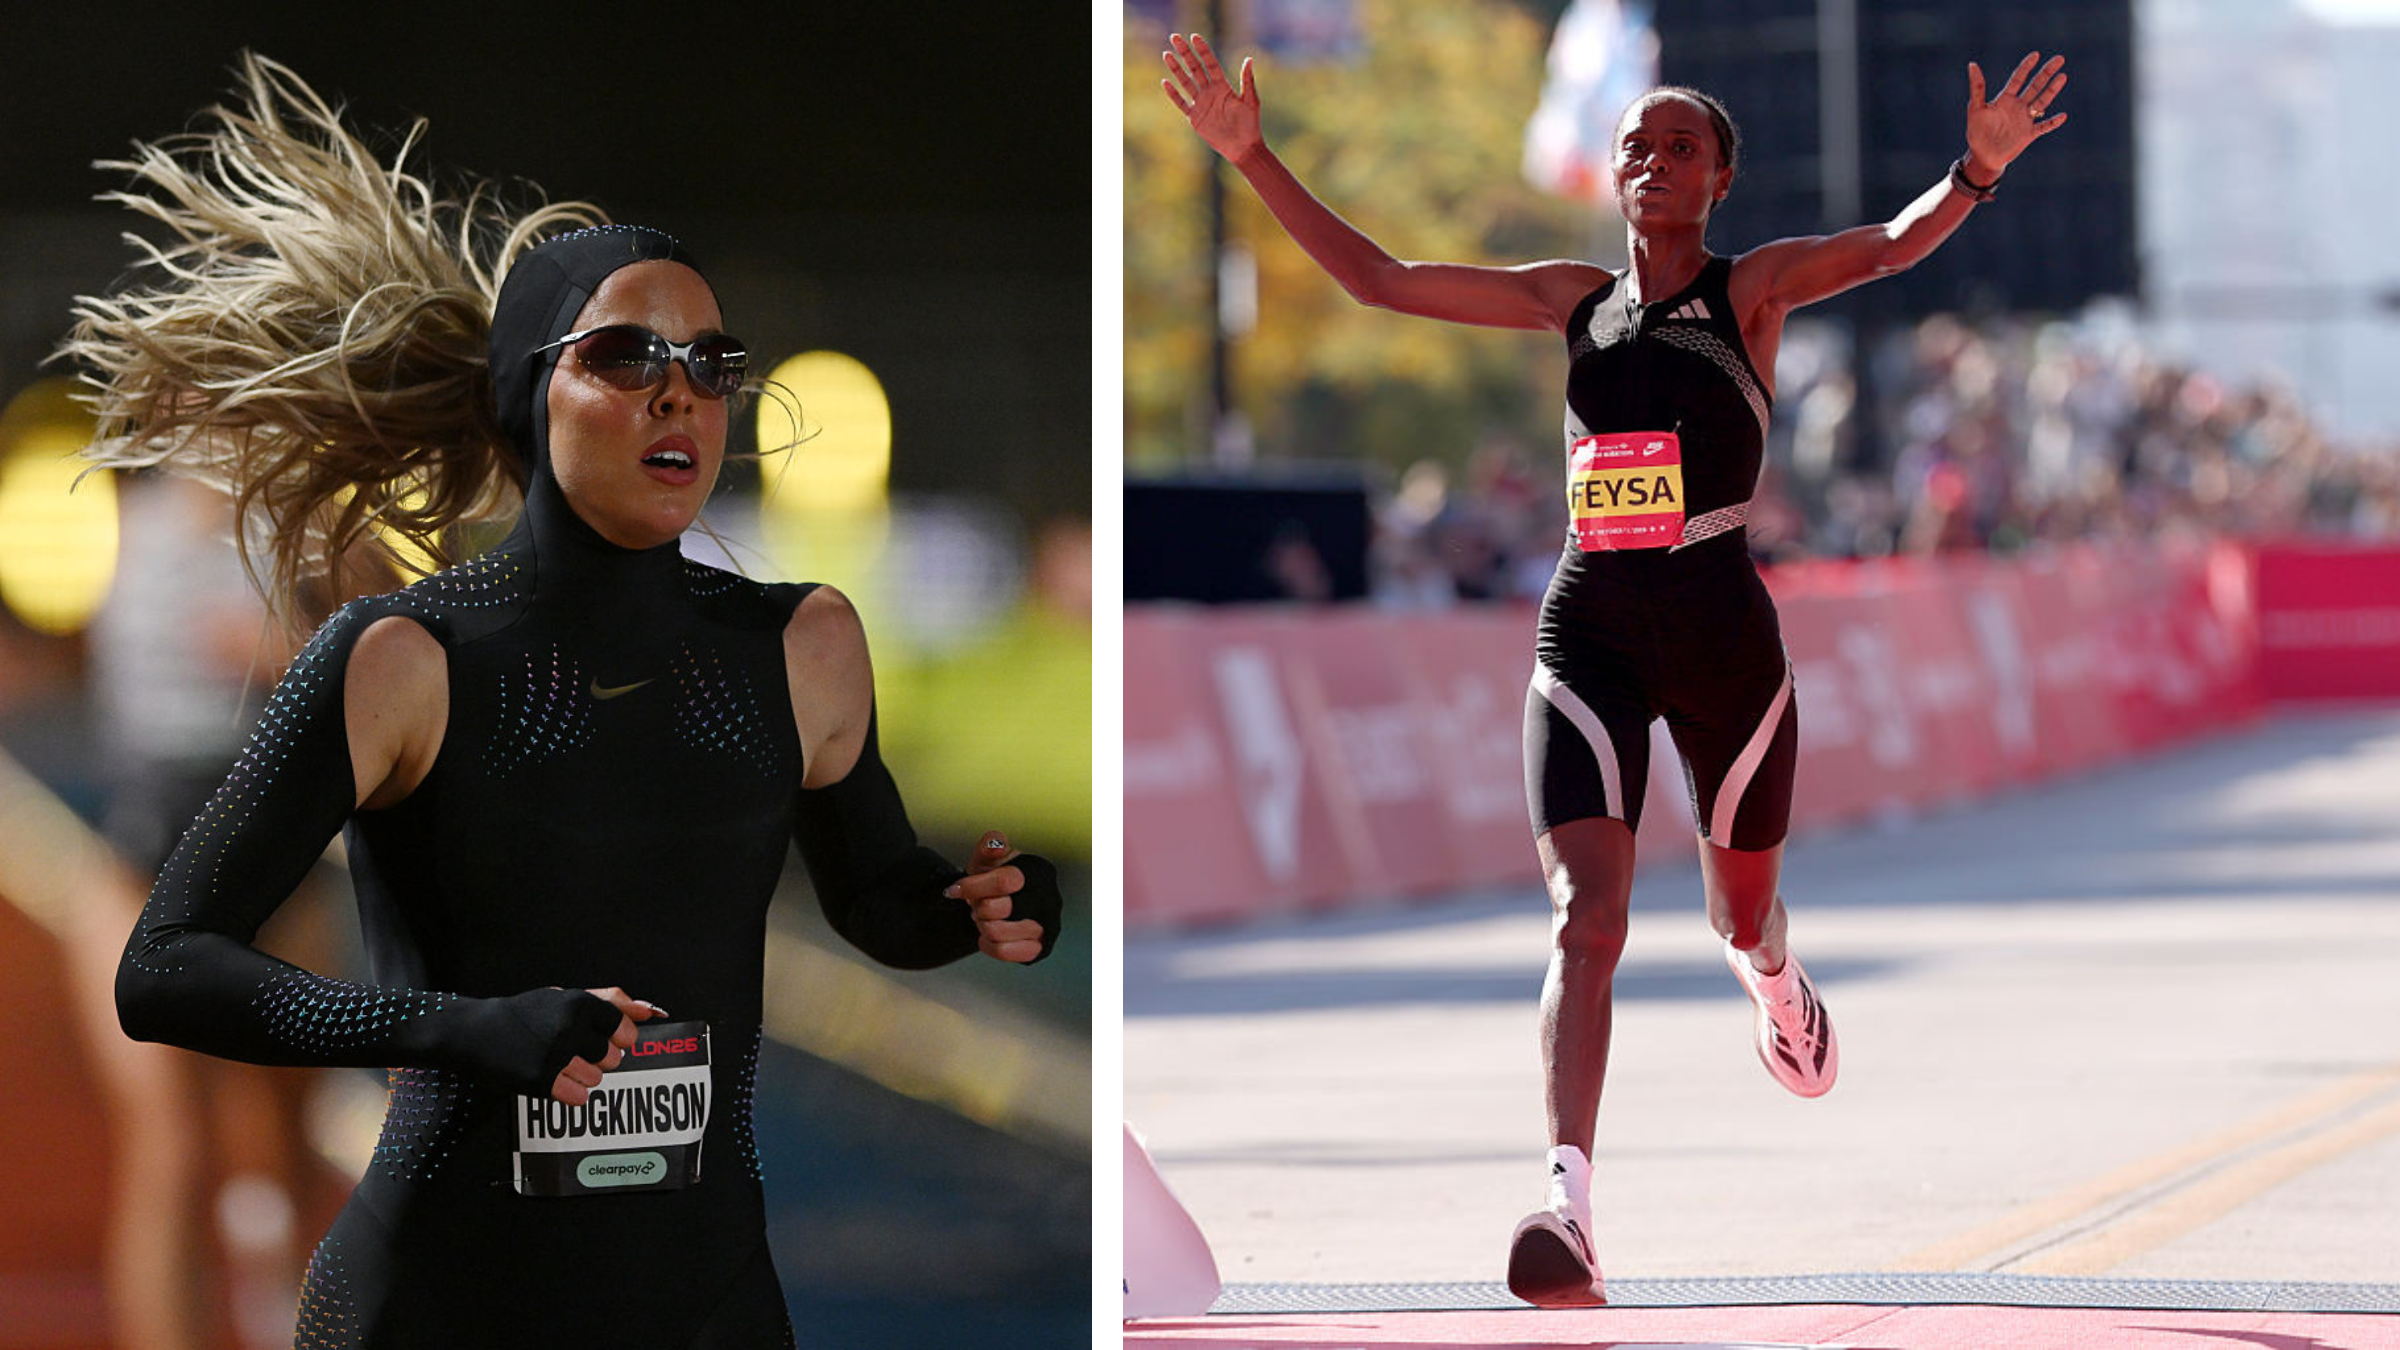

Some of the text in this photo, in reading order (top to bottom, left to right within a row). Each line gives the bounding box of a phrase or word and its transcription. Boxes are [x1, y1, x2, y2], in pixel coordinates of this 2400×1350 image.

[1572, 476, 1675, 509] FEYSA
[527, 1082, 705, 1139] HODGKINSON
[588, 1164, 642, 1176] clearpay
